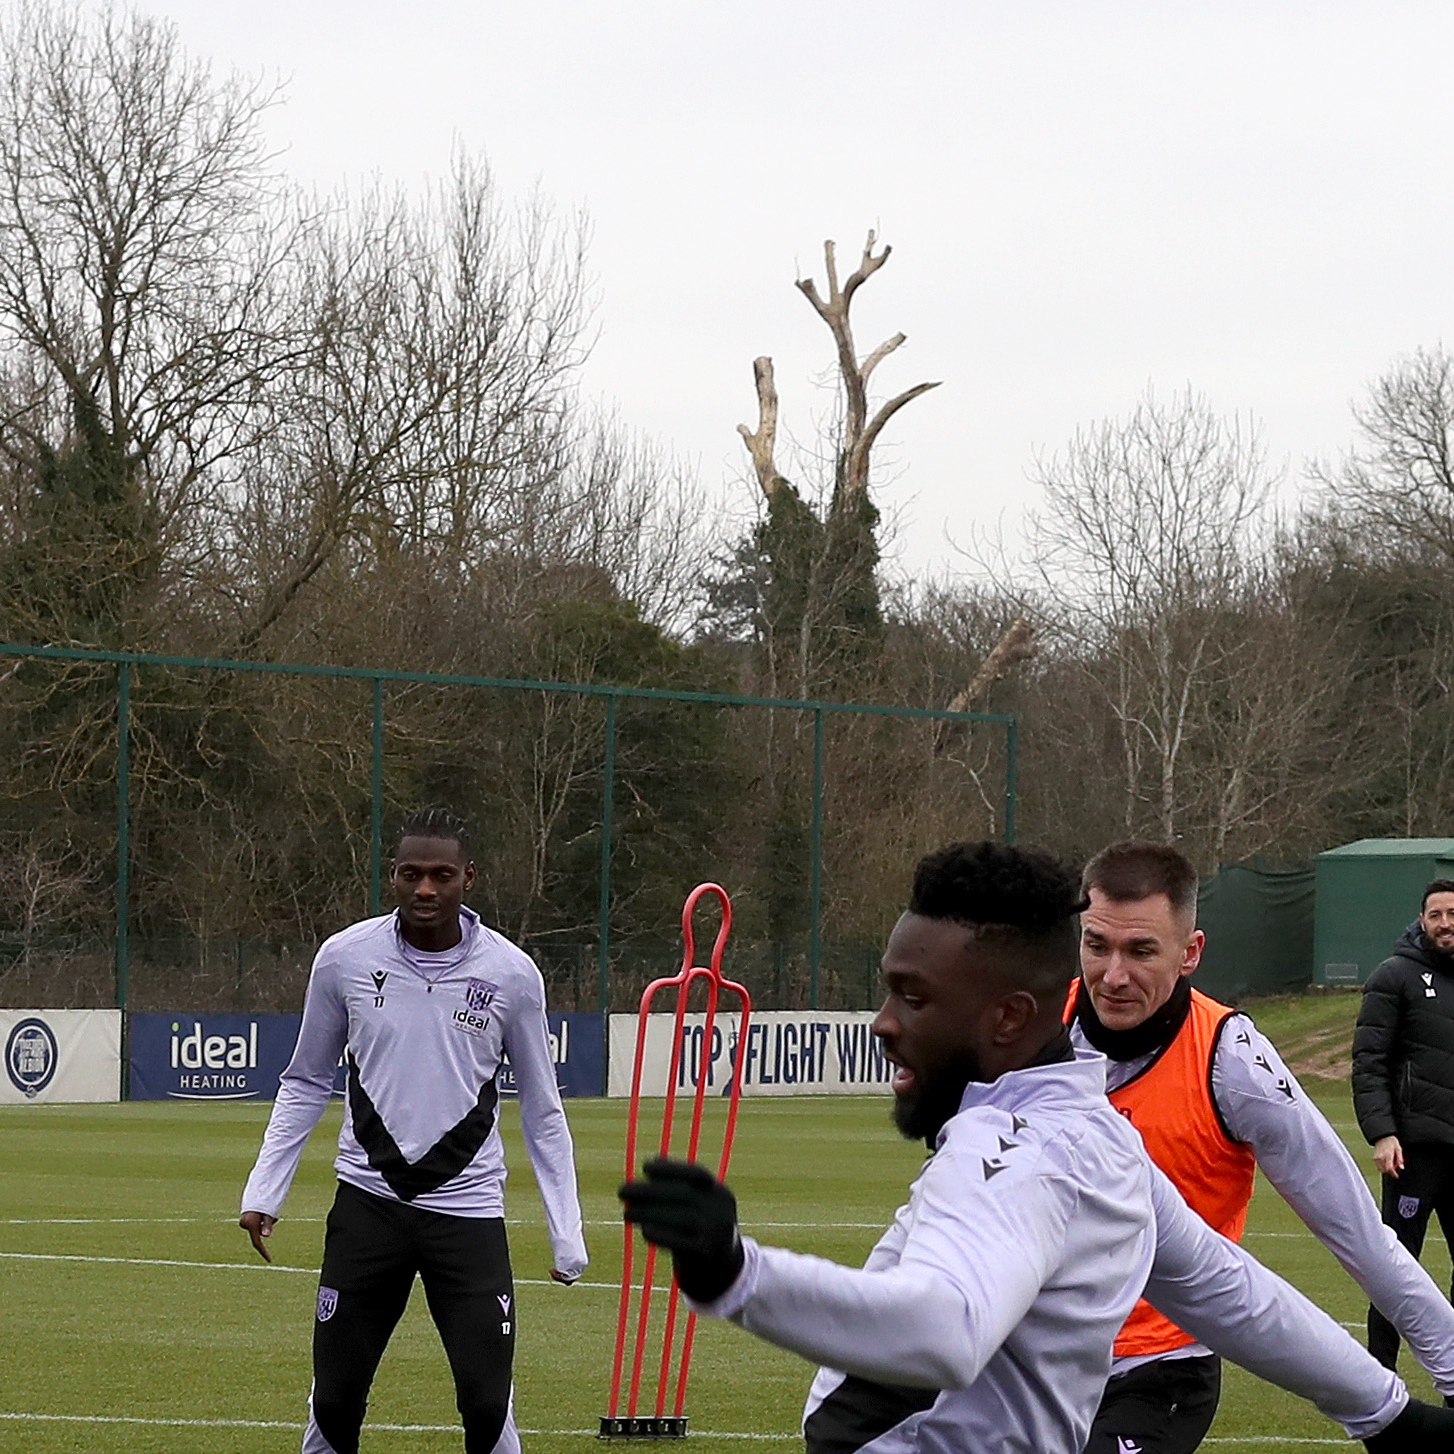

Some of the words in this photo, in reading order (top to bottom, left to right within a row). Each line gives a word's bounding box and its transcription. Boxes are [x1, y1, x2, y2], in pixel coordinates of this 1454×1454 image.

[452, 1007, 490, 1031] ideal
[171, 1022, 258, 1069] ideal
[678, 1025, 723, 1087] TOP
[745, 1023, 831, 1085] FLIGHT
[180, 1074, 246, 1089] HEATING
